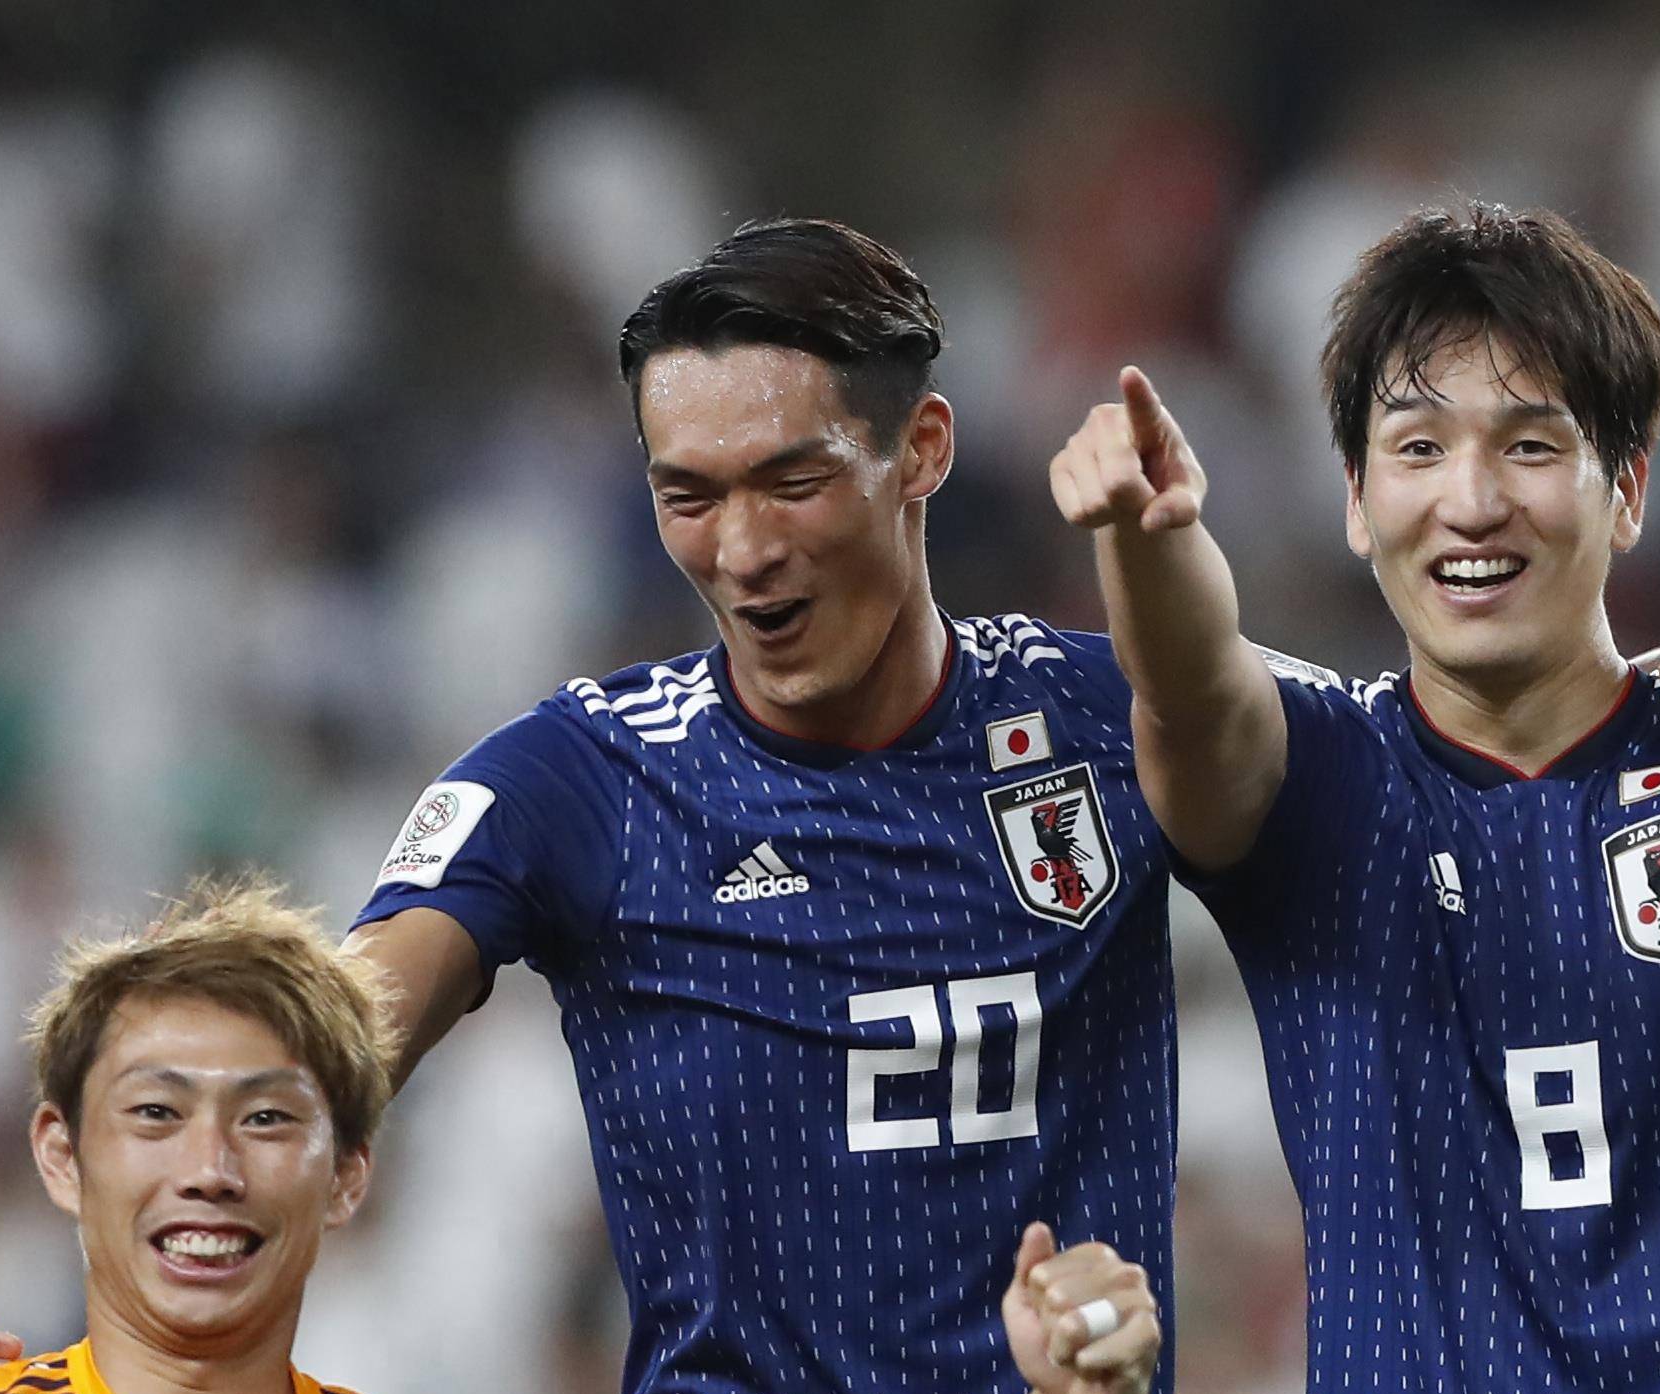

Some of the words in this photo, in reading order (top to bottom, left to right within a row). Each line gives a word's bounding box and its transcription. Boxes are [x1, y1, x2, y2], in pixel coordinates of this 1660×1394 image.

[1014, 776, 1067, 802] JAPAN
[715, 875, 810, 903] adidas
[846, 970, 1043, 1153] 20
[1505, 1040, 1612, 1211] 8
